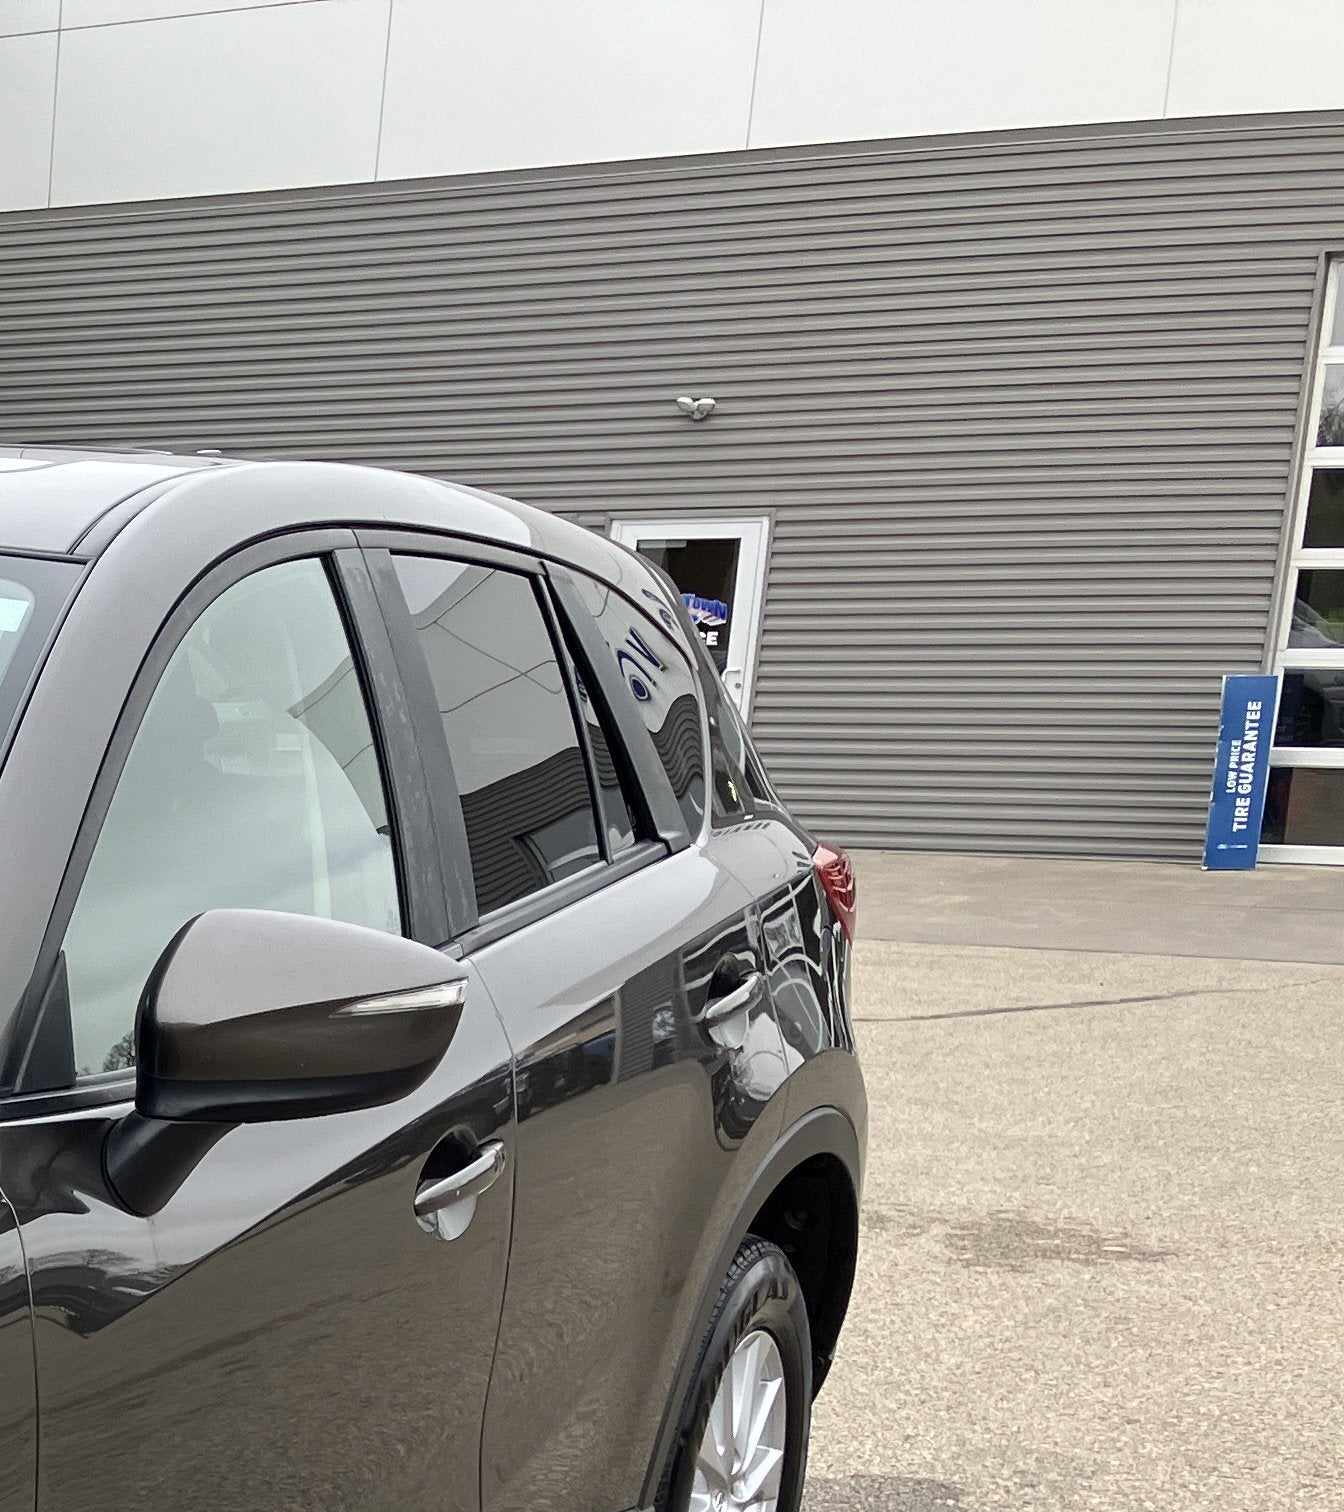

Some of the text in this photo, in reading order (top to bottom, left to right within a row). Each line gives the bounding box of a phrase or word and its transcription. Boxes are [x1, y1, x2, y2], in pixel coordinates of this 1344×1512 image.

[1226, 740, 1242, 793] LOW PRICE
[1233, 700, 1262, 832] TIRE GUARANTEE
